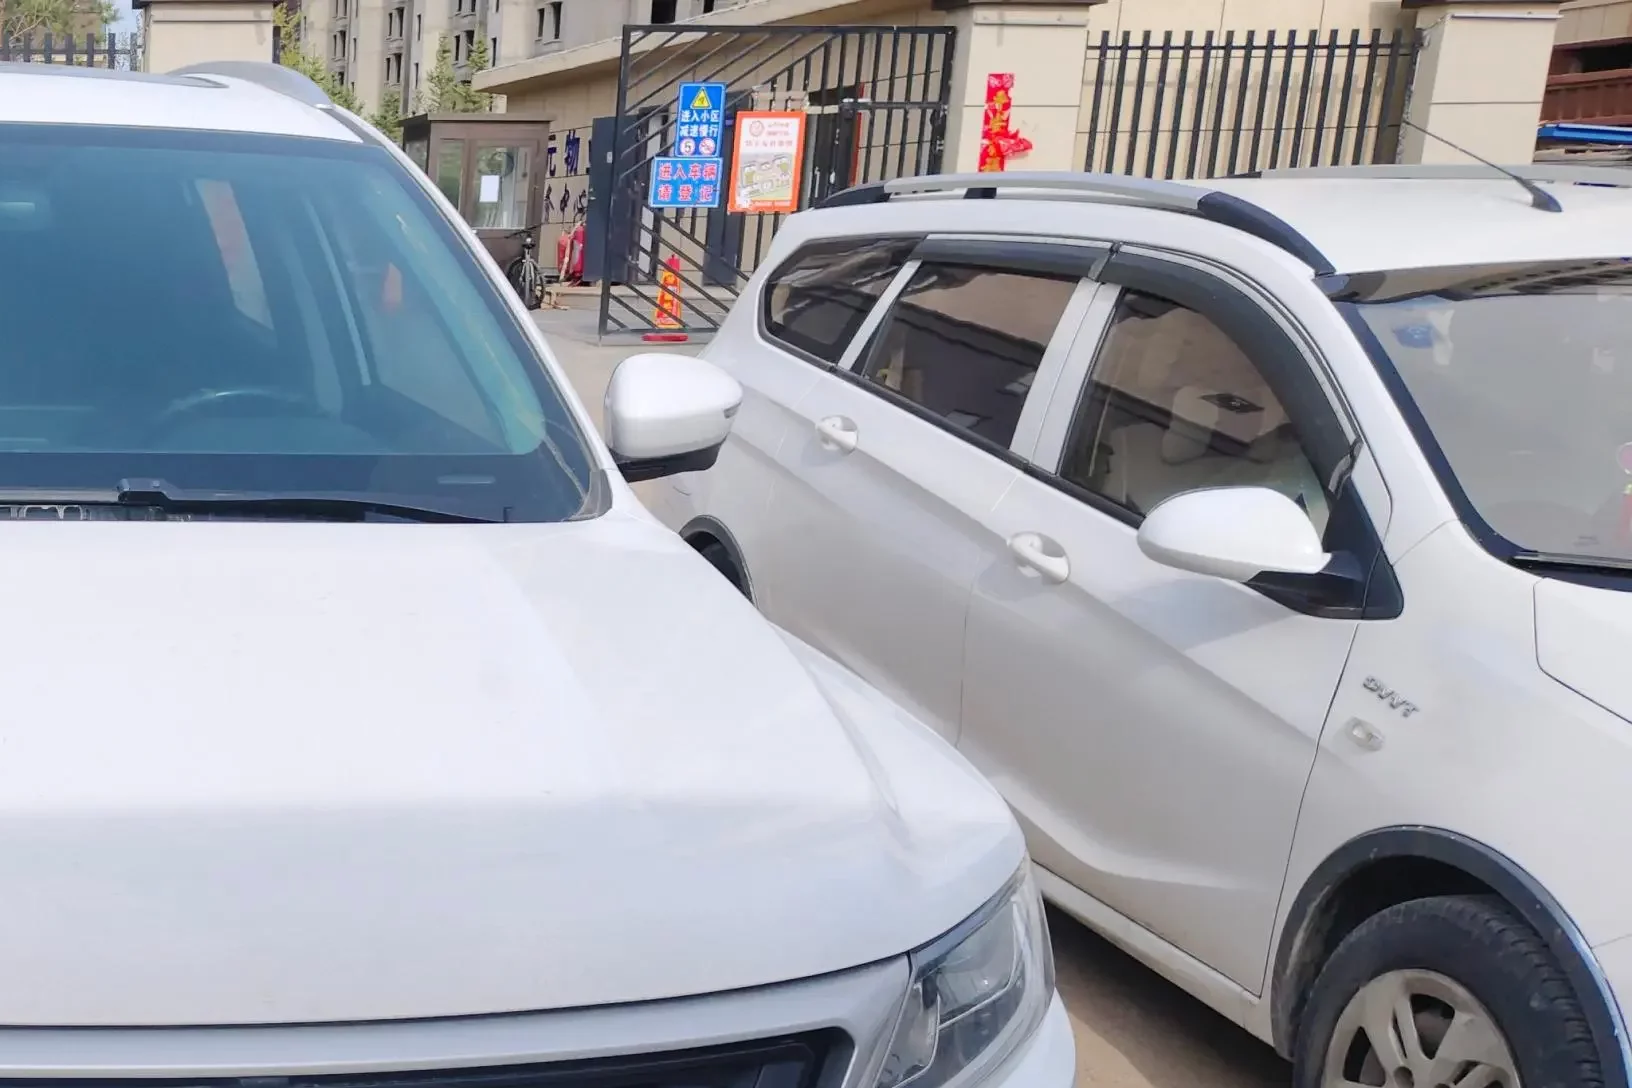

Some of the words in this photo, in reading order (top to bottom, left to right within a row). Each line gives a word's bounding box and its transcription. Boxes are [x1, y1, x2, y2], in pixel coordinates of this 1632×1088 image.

[681, 110, 720, 123] 进入小区
[679, 125, 718, 137] 减速慢行
[658, 163, 717, 180] 进入车辆
[658, 184, 713, 200] 请登记
